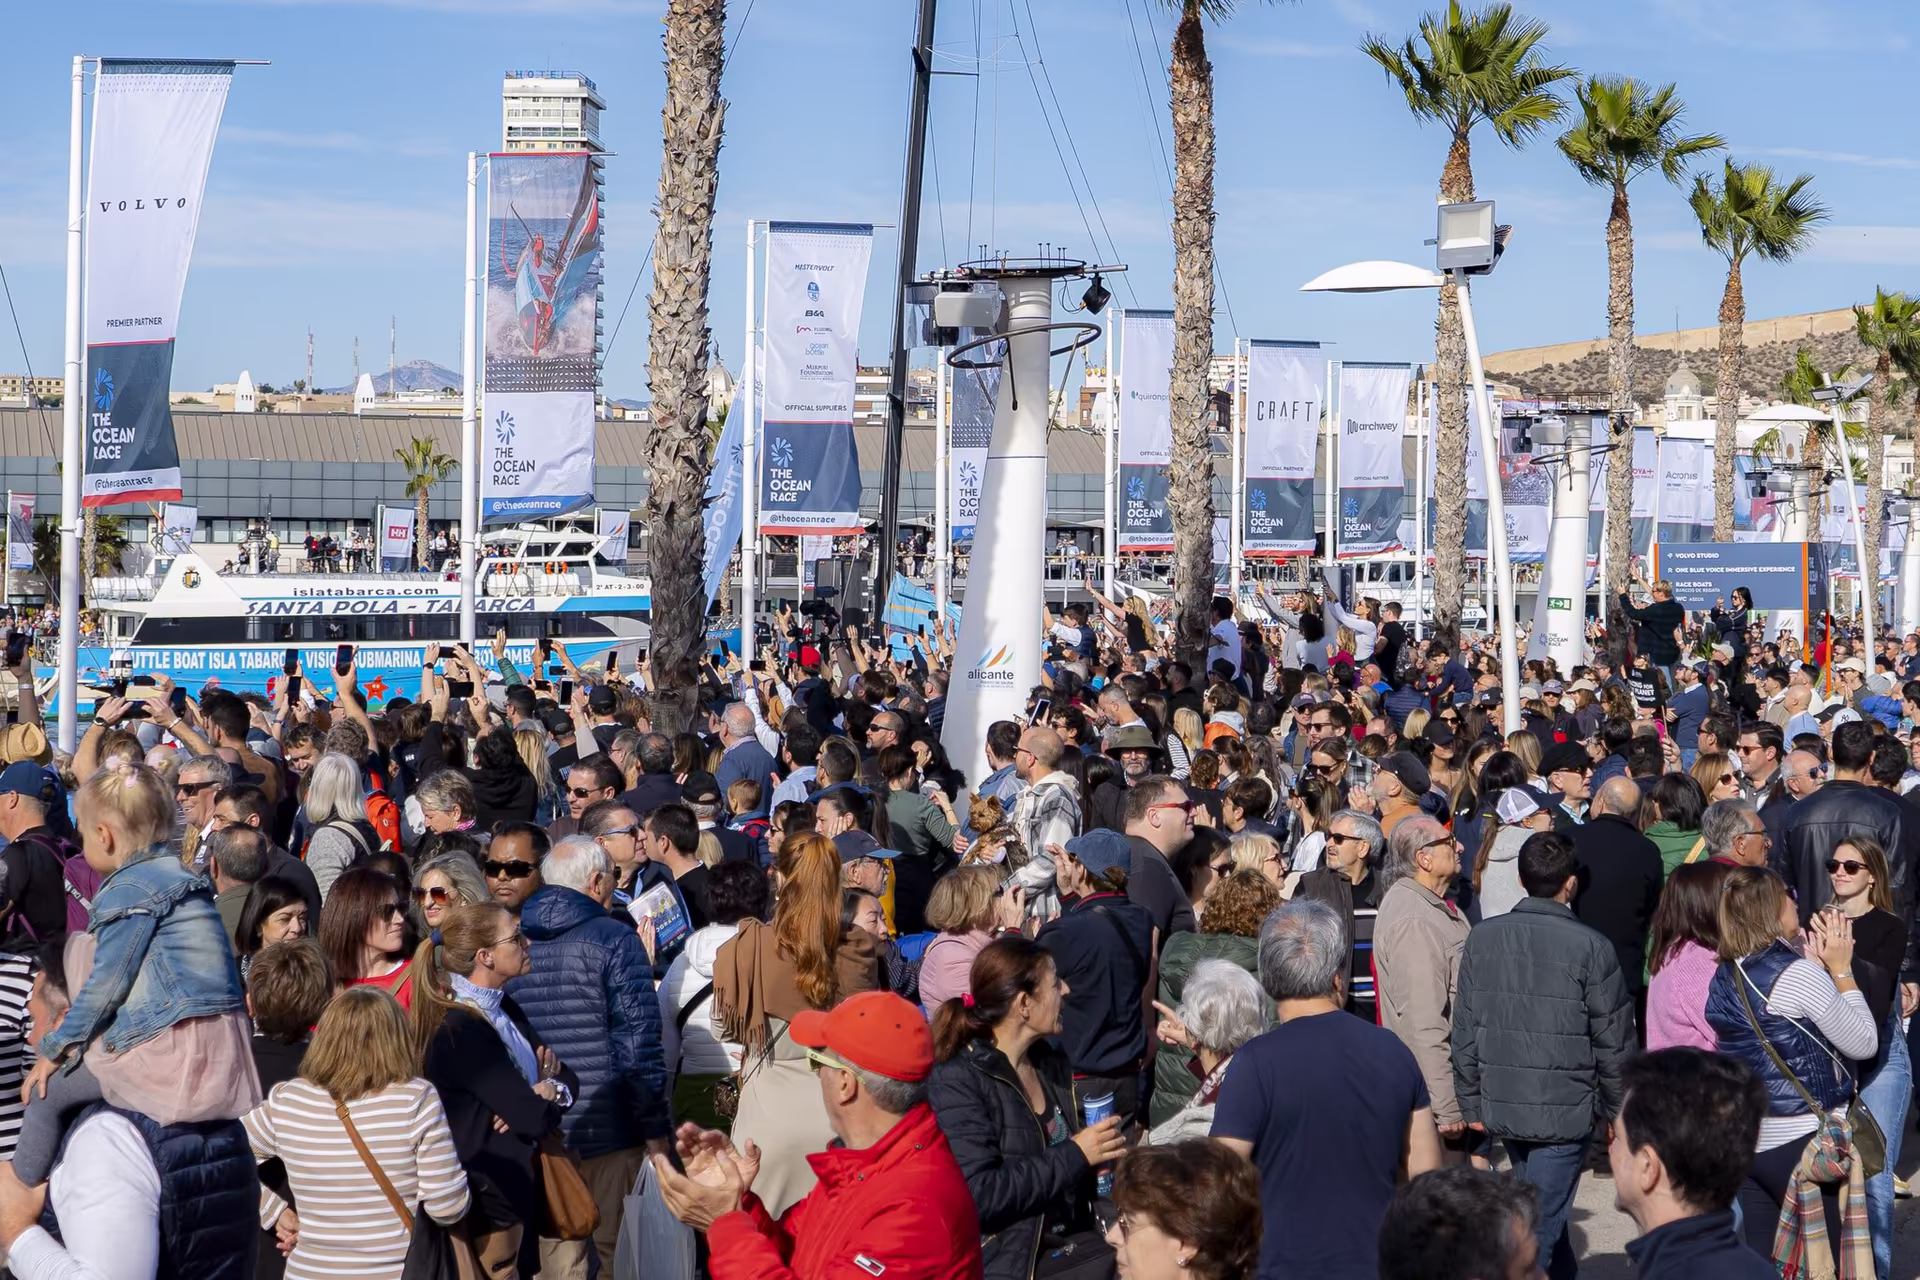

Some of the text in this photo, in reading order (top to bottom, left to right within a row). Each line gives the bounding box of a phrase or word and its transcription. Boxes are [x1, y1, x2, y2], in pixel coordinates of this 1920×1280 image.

[516, 70, 567, 79] HOTEL
[100, 197, 186, 213] VOLVO
[106, 317, 162, 328] PREMIER PARTNER
[1257, 400, 1314, 422] CRAFT
[92, 412, 112, 426] THE
[1359, 420, 1398, 432] archwey
[92, 428, 136, 444] OCEAN
[94, 446, 122, 460] RACE
[494, 448, 514, 458] THE
[493, 460, 536, 472] OCEAN
[770, 468, 792, 479] THE
[1666, 471, 1698, 480] Acronis
[493, 475, 520, 486] RACE
[770, 480, 812, 491] OCEAN
[770, 492, 797, 502] RACE
[960, 488, 978, 496] THE
[960, 498, 980, 507] OC
[960, 509, 979, 517] RAC
[1127, 509, 1162, 518] OCEAN
[770, 514, 836, 524] @theoceanrace
[1250, 518, 1283, 526] OCEAN
[390, 527, 406, 538] HH
[293, 586, 439, 597] islatabarca.com
[245, 601, 324, 615] SANTA
[332, 600, 398, 614] POLA
[426, 598, 535, 613] TAARCA
[132, 651, 170, 669] UTTLE
[174, 652, 207, 669] BOAT
[209, 651, 236, 669] ISLA
[240, 651, 286, 669] TABARC
[306, 651, 336, 668] VISIO
[353, 651, 420, 668] SUBMARINA
[968, 668, 1014, 680] alicante
